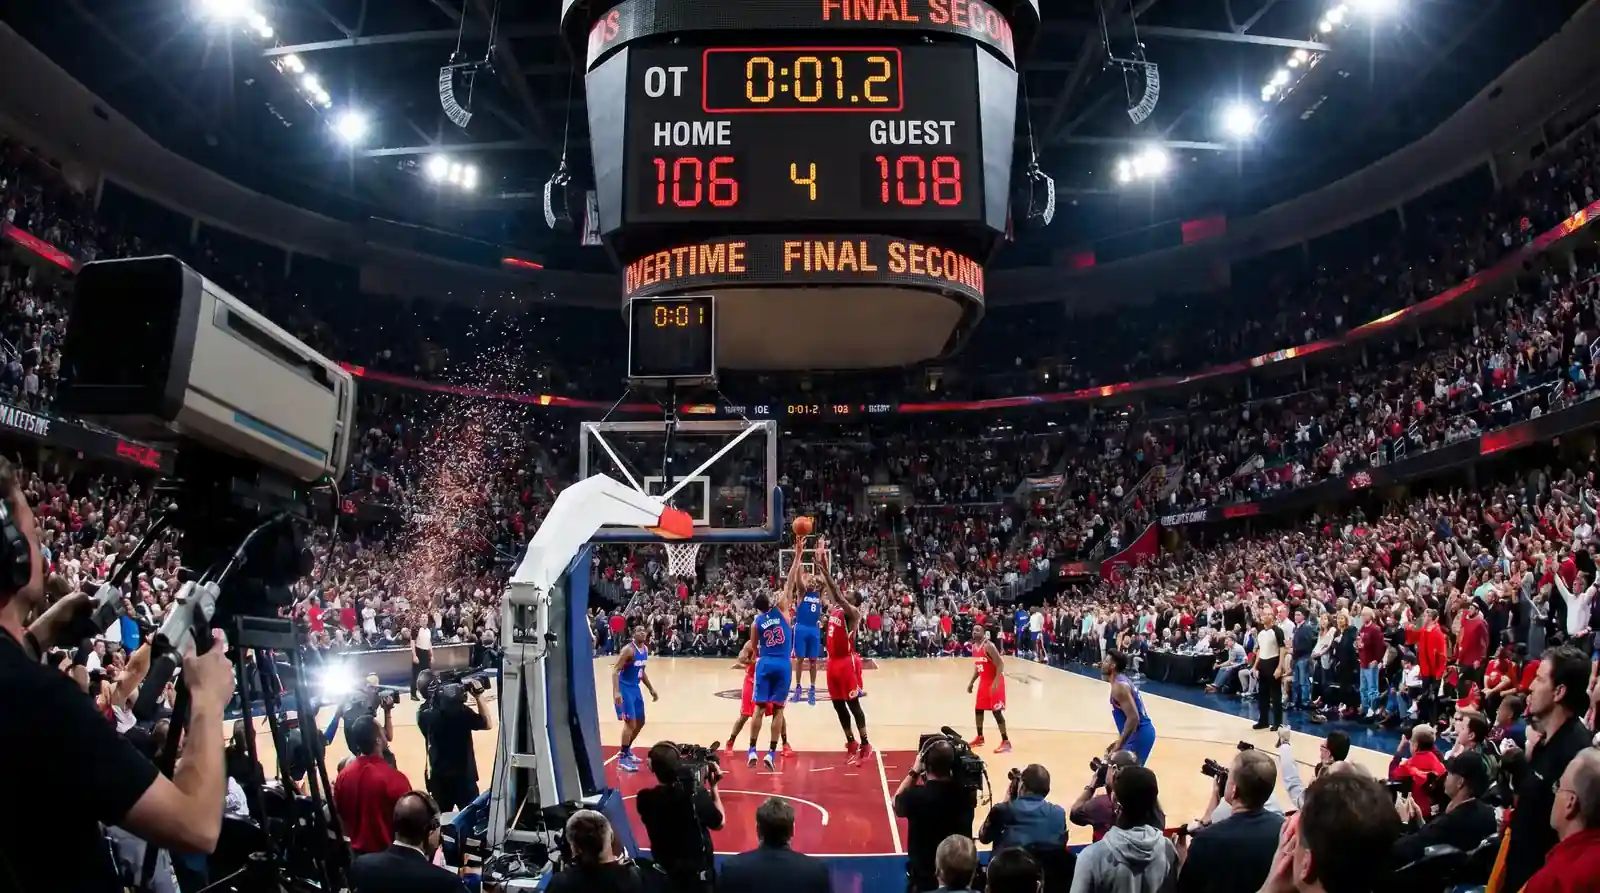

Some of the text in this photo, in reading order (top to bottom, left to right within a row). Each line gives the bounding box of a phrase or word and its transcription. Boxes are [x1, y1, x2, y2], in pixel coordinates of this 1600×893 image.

[823, 0, 919, 22] FINAL
[644, 66, 688, 98] OT
[746, 56, 891, 103] 0:01.2
[653, 121, 731, 146] HOME
[869, 120, 956, 146] GUEST
[653, 156, 738, 207] 106
[790, 162, 817, 201] 4
[875, 156, 962, 206] 108
[626, 242, 746, 294] OVERTIME
[783, 241, 878, 272] FINAL
[654, 305, 704, 327] 0:01
[763, 626, 786, 648] 23
